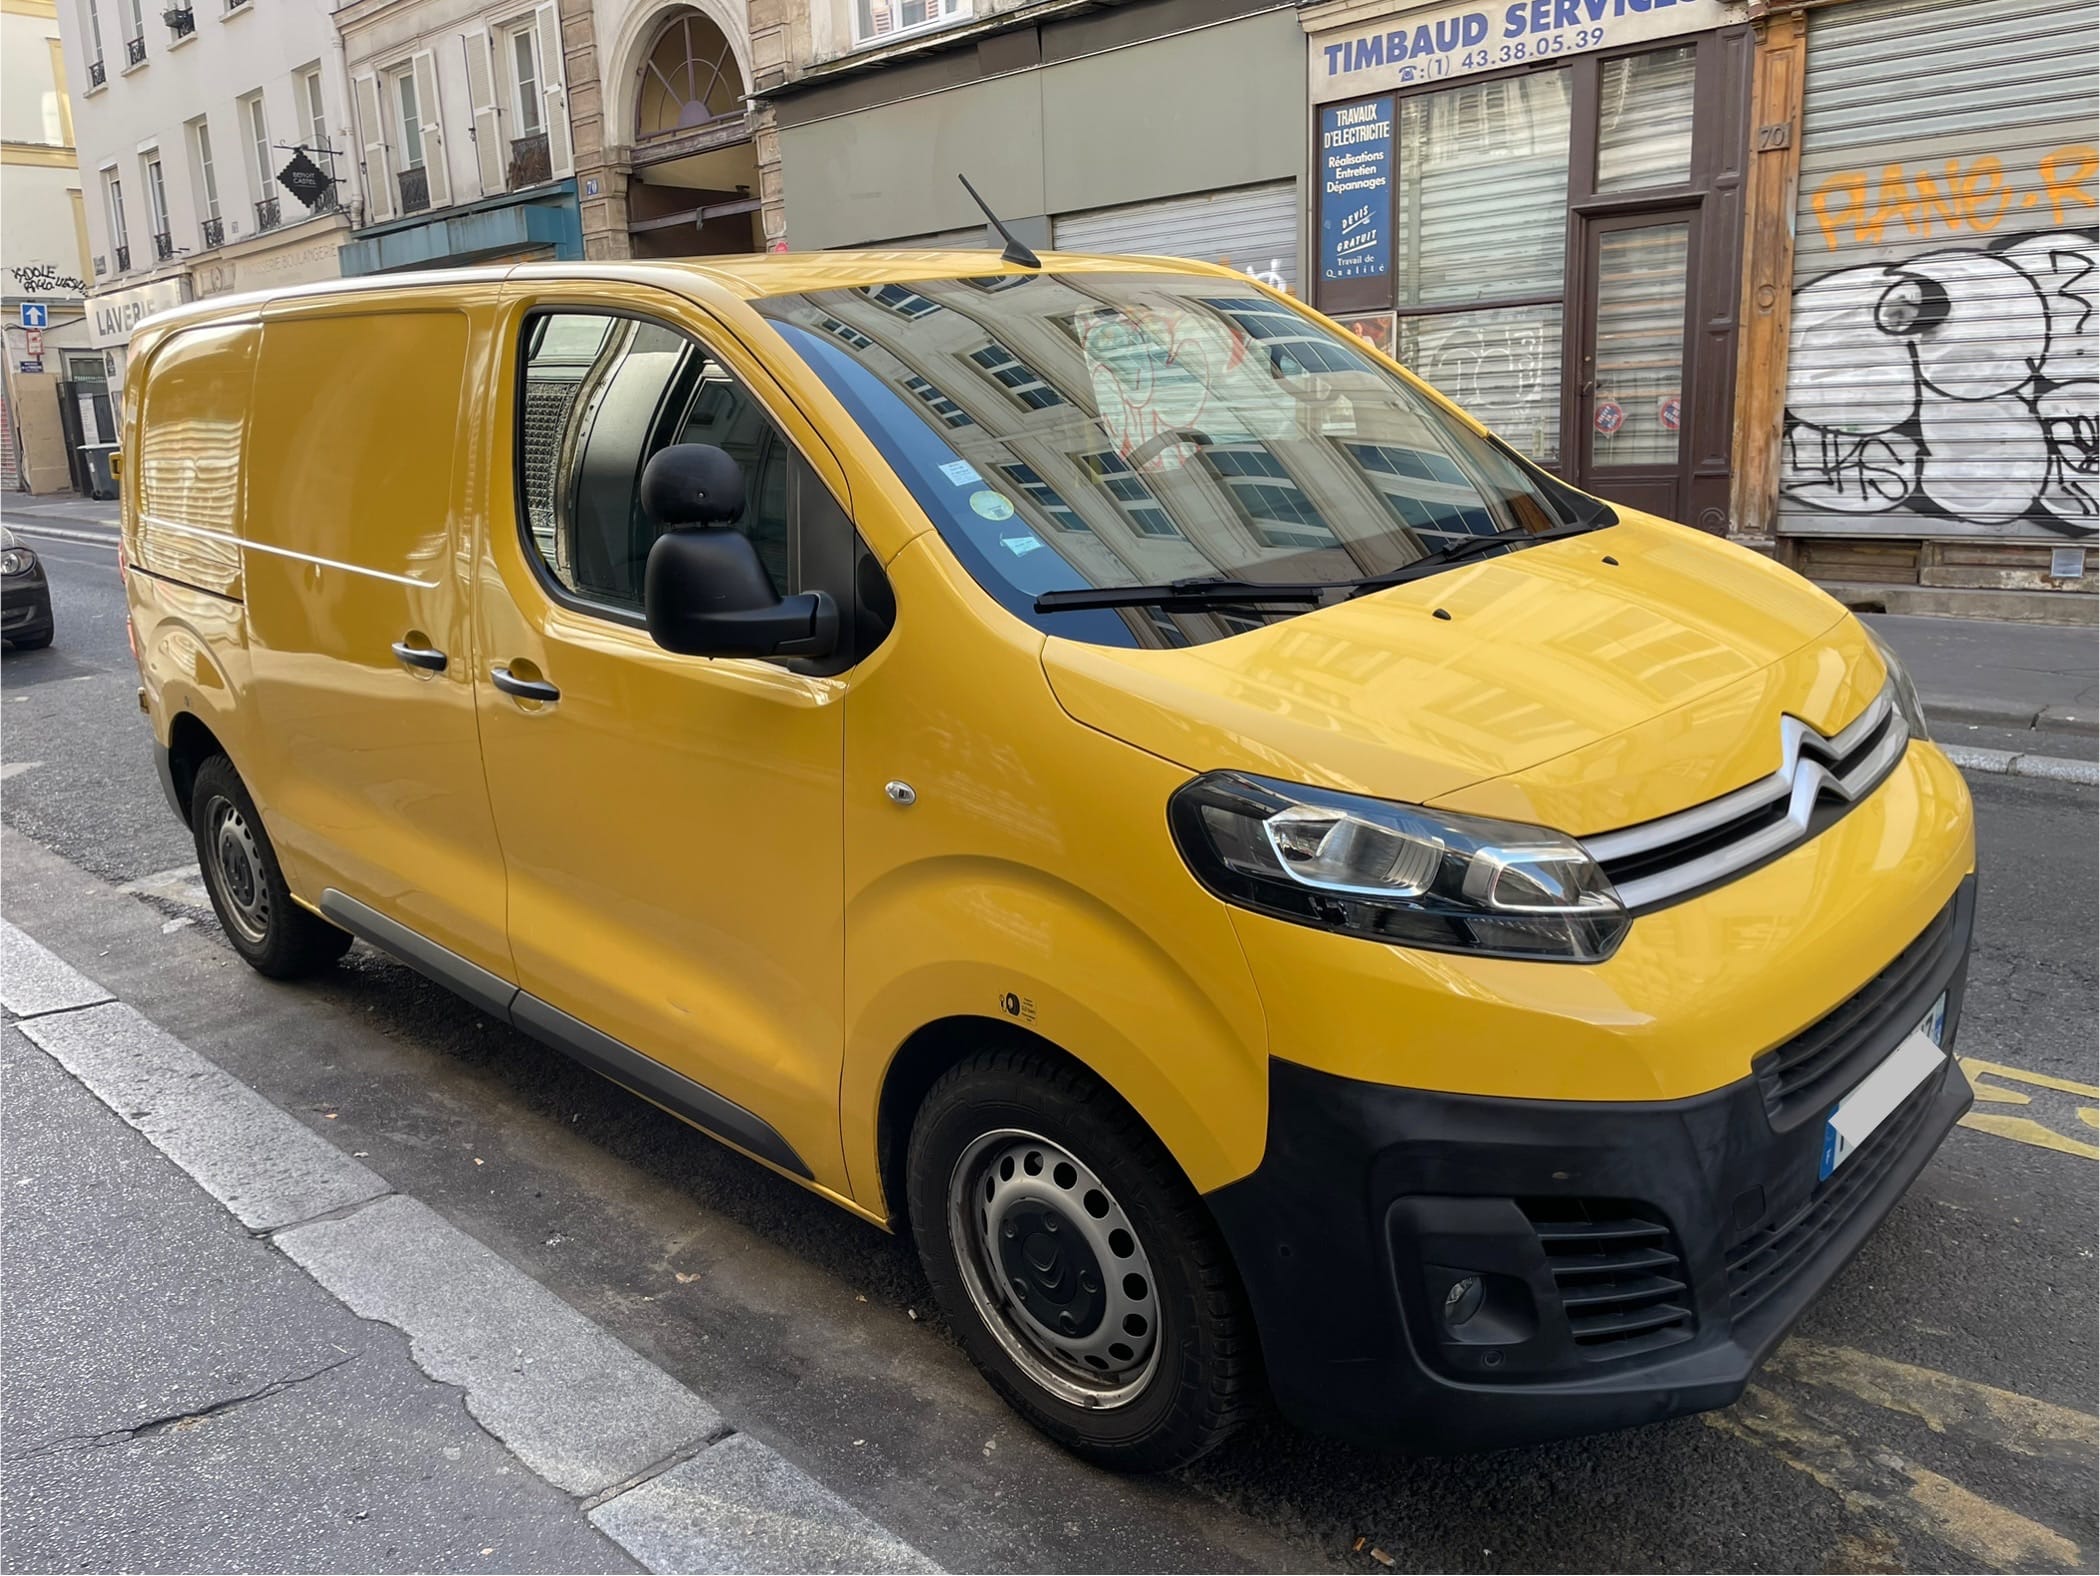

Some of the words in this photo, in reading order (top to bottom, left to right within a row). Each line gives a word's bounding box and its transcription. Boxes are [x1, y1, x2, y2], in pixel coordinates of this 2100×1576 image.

[1324, 13, 1489, 76] TIMBAUD
[1503, 0, 1697, 38] SERVI
[1462, 27, 1604, 69] 43.38.05.39
[1336, 103, 1378, 127] TRAVAUX
[1324, 121, 1391, 148] D'ELECTRICITE
[1761, 127, 1785, 148] 70
[1328, 150, 1385, 168] Réalisations
[1336, 164, 1377, 179] Entretien
[586, 179, 598, 195] 70
[1327, 177, 1386, 194] Dépannages
[1342, 205, 1369, 229] DEVIS
[1337, 229, 1377, 252] GRATUIT
[1337, 255, 1363, 267] Travail
[1364, 254, 1375, 263] de
